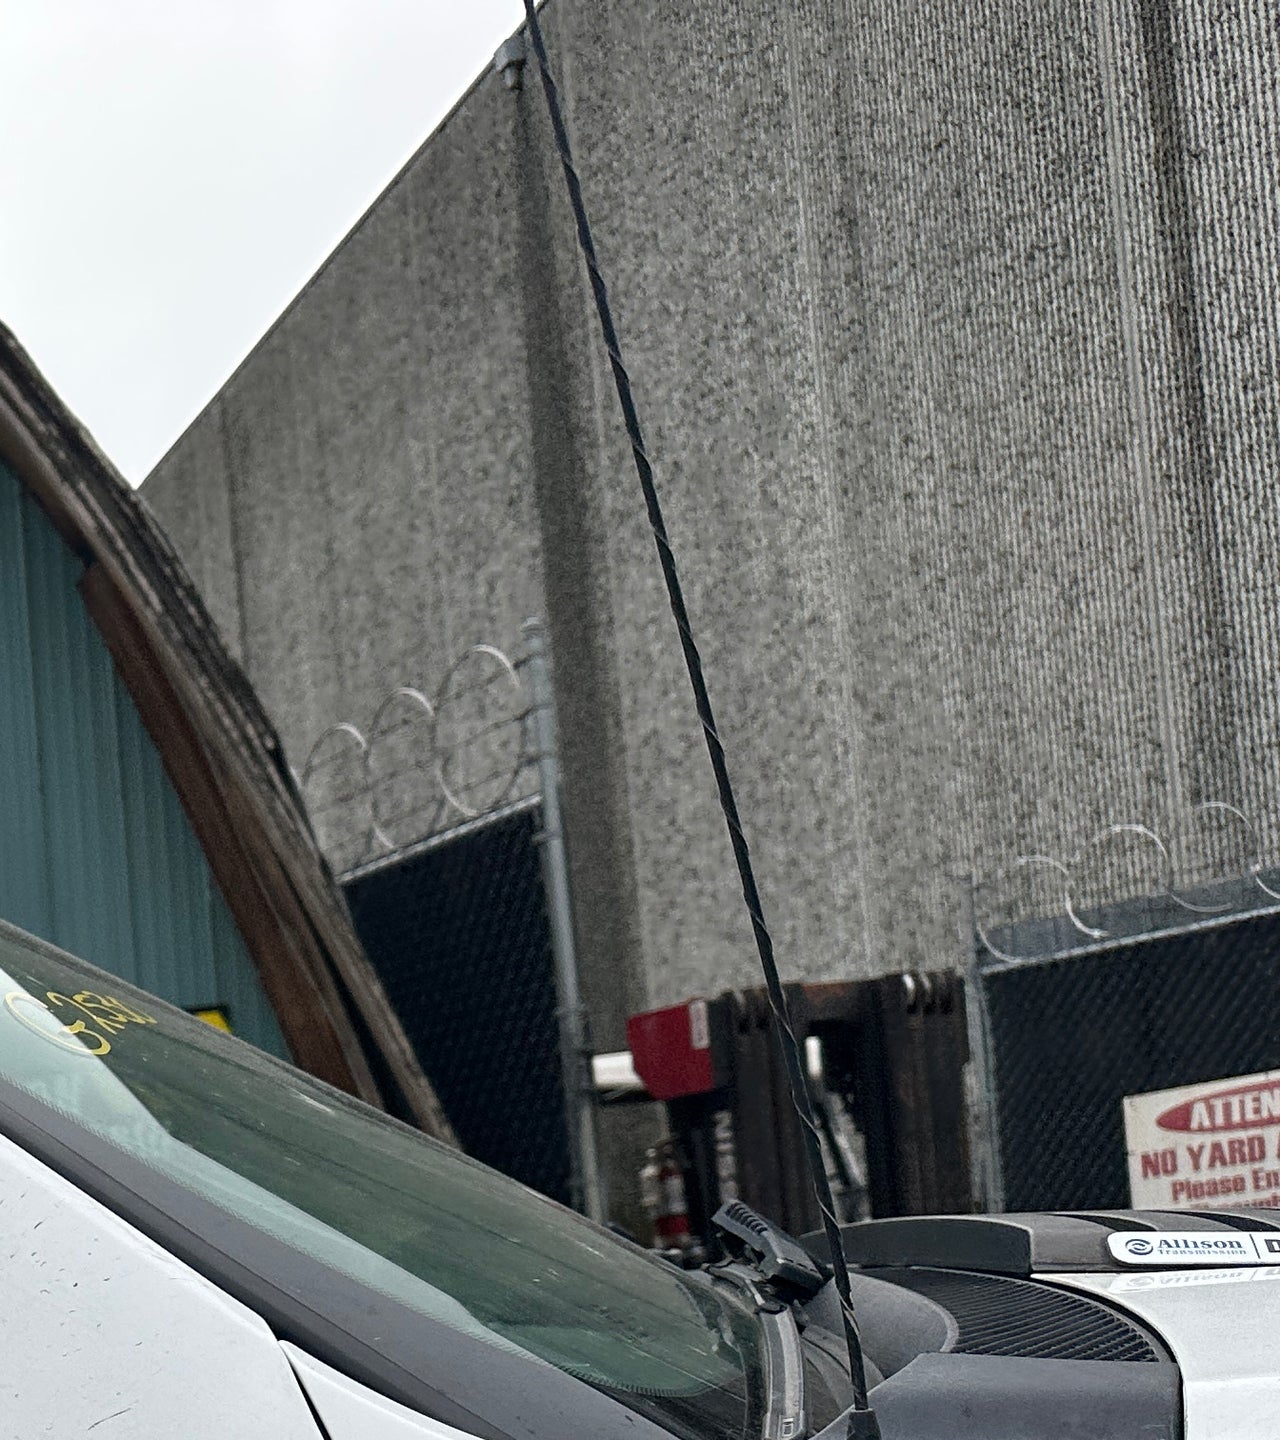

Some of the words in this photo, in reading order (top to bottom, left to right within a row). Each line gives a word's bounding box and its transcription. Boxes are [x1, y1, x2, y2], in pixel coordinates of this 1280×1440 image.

[1140, 1147, 1178, 1180] NO
[1186, 1133, 1266, 1172] YARD
[1171, 1174, 1246, 1203] Please
[1158, 1238, 1244, 1250] Allison
